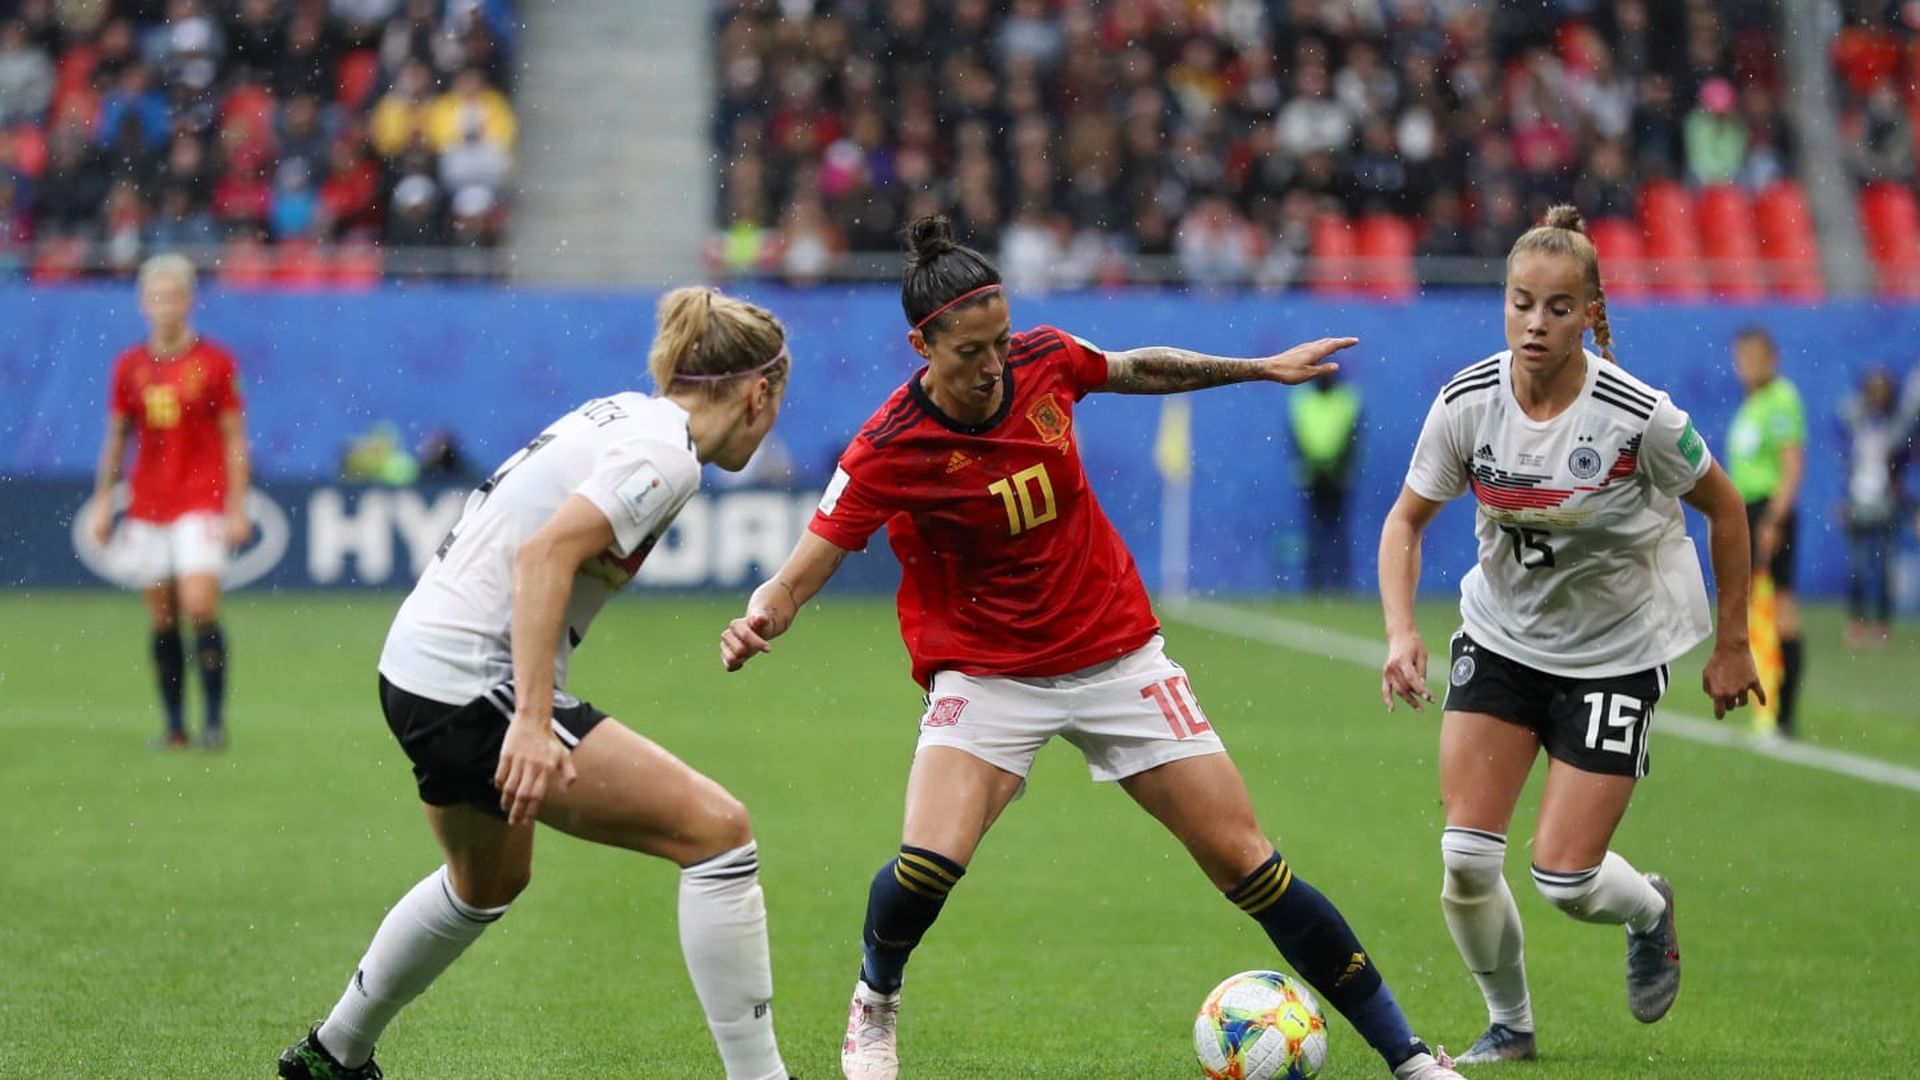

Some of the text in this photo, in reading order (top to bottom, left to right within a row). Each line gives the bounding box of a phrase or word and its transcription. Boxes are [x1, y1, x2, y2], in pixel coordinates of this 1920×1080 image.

[988, 463, 1057, 536] 10
[1499, 524, 1555, 570] 15
[1140, 676, 1210, 741] 10
[1583, 692, 1642, 755] 15
